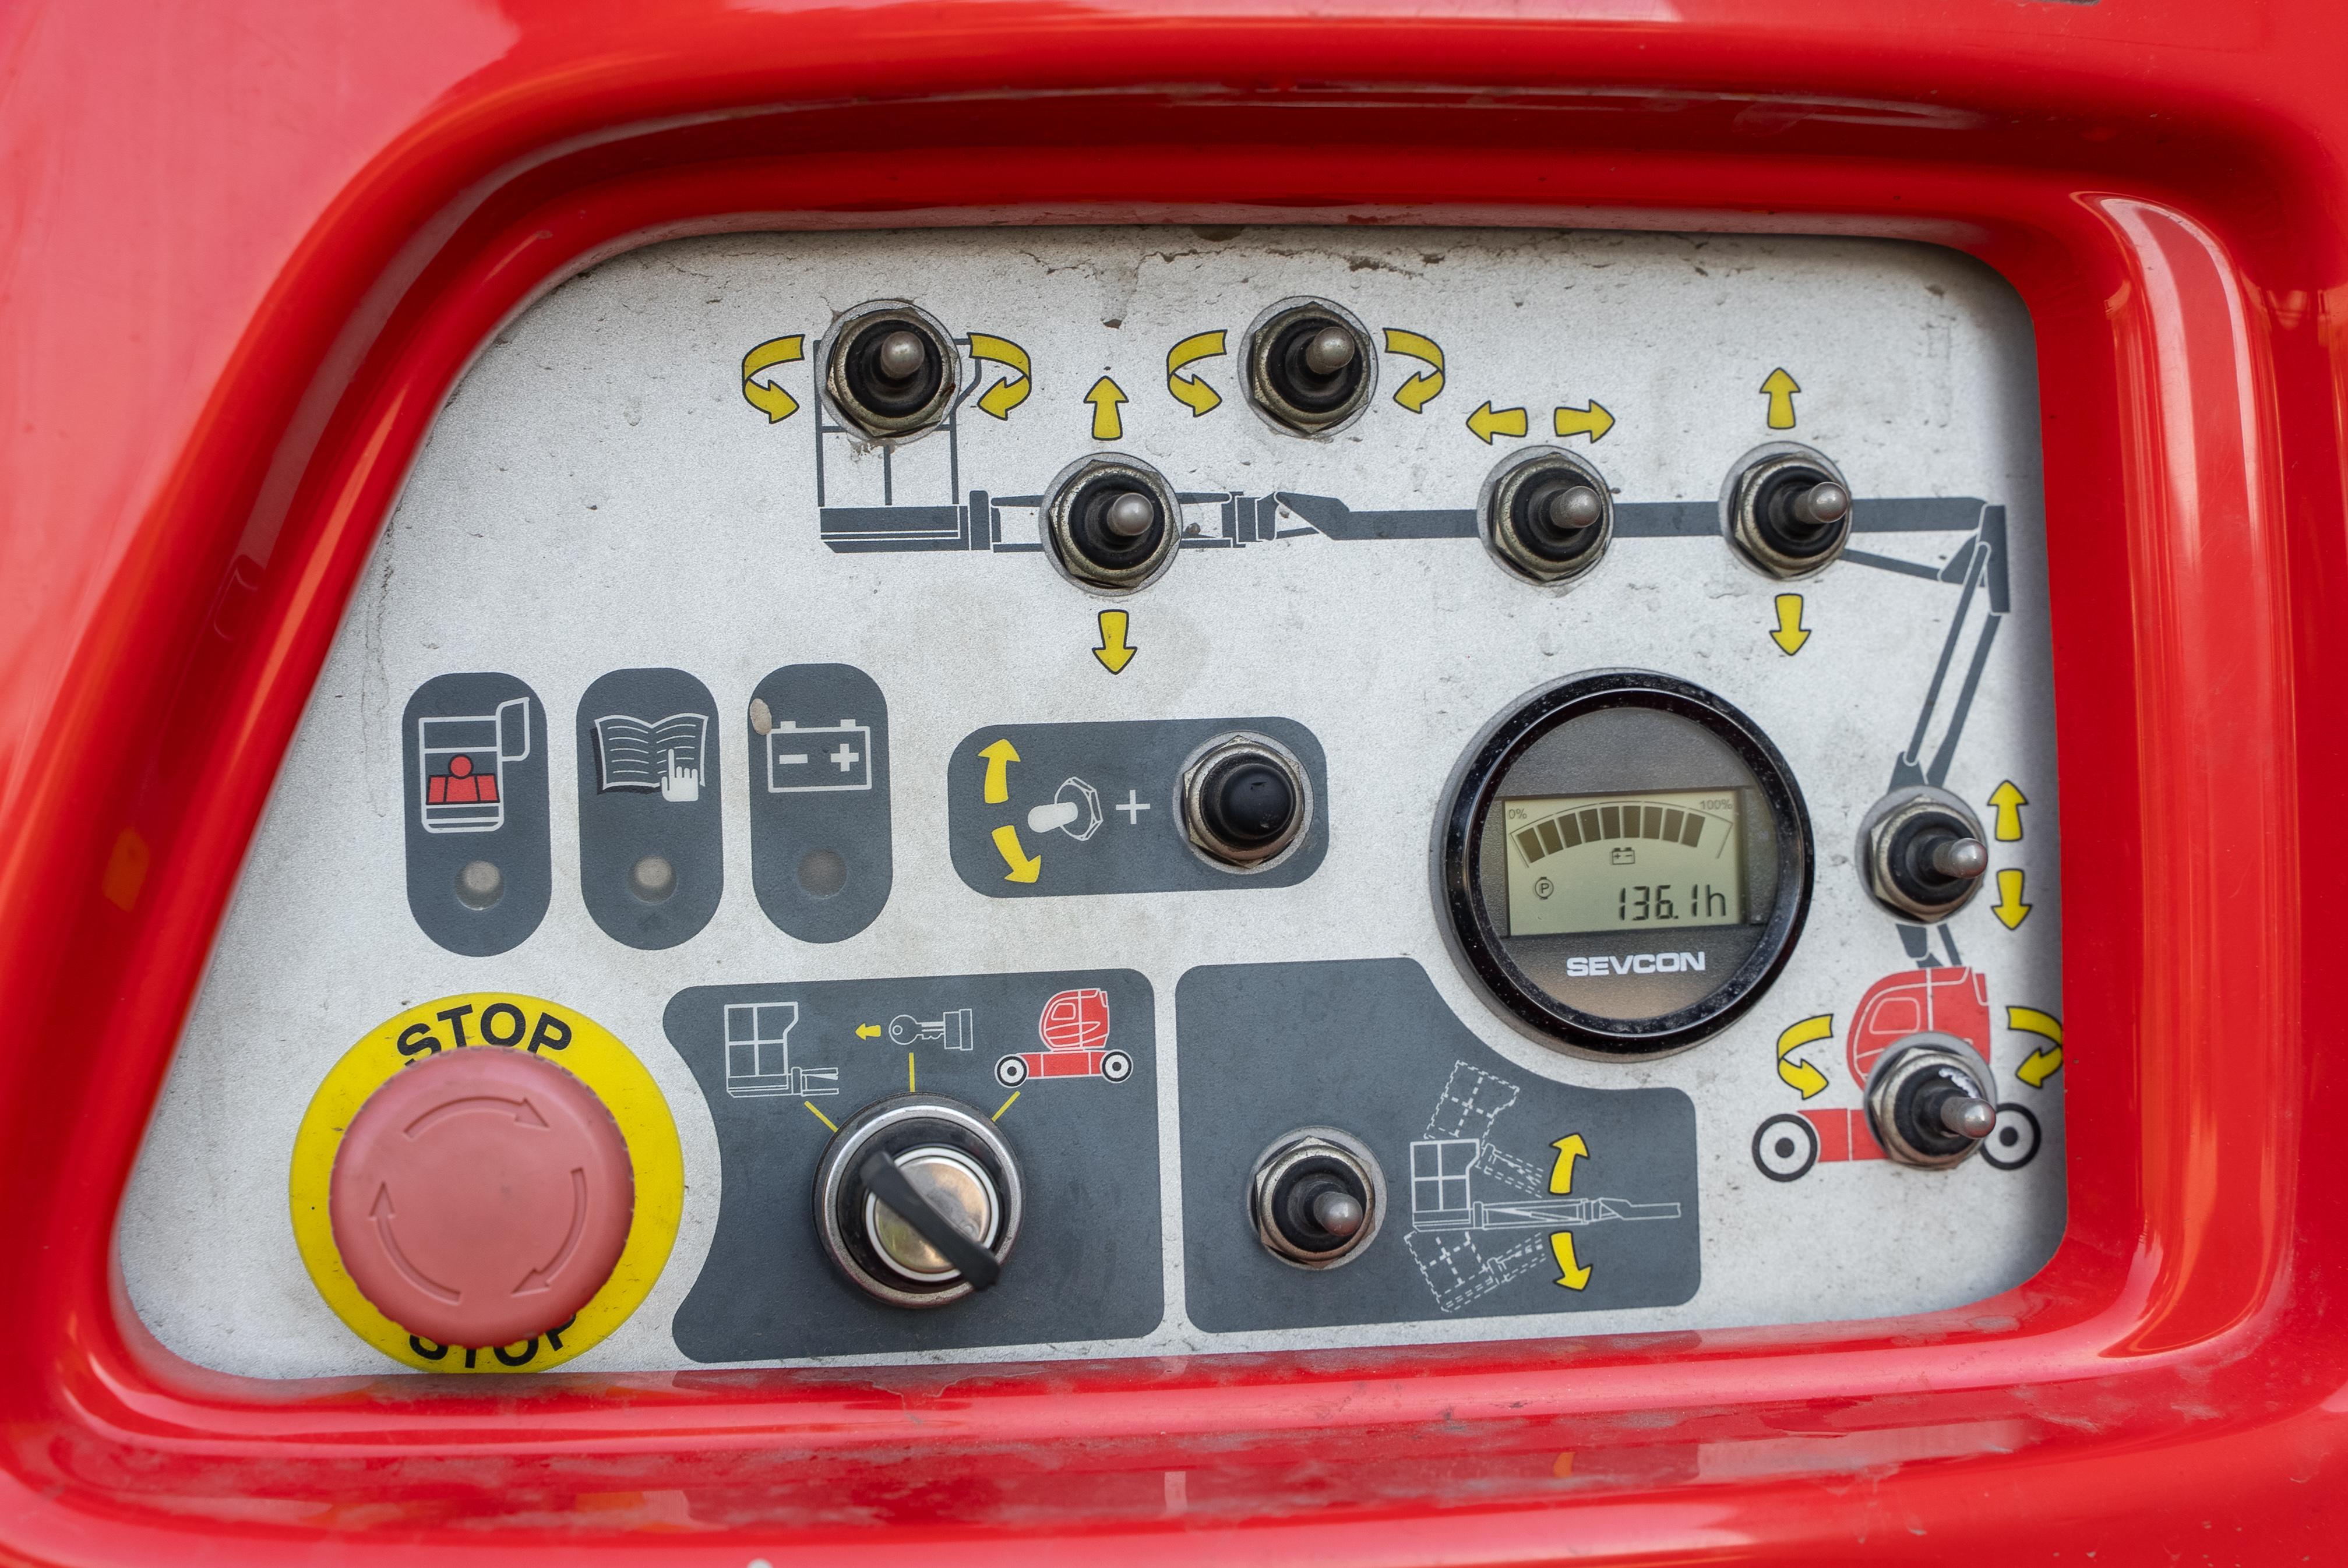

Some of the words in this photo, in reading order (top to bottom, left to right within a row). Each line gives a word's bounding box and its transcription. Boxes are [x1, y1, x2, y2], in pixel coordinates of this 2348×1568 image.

[1508, 808, 1528, 820] 0%
[1700, 799, 1733, 810] 100%
[1619, 884, 1726, 921] 136.1h
[1566, 951, 1706, 977] SEVCON
[396, 1002, 572, 1066] STOP
